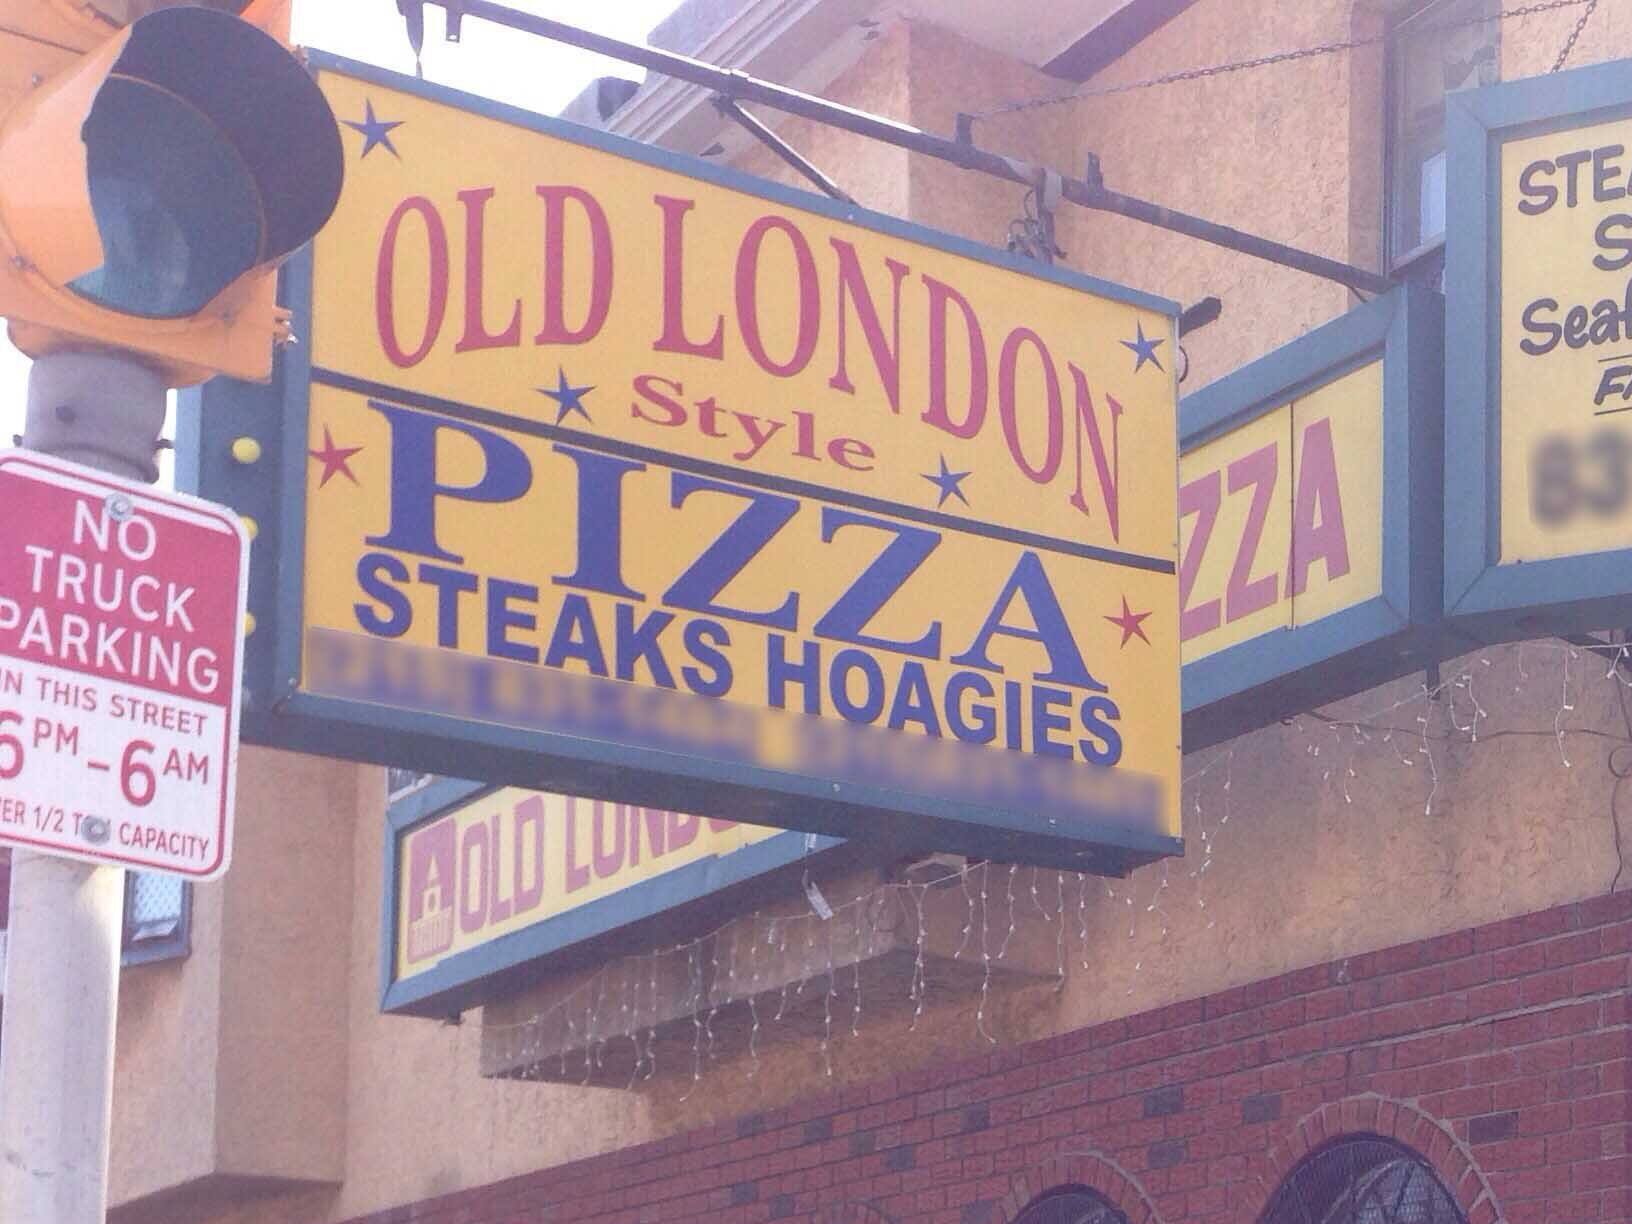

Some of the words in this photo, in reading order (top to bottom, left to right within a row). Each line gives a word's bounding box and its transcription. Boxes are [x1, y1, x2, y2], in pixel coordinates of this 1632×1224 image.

[375, 185, 614, 368] OLD
[653, 194, 1124, 543] LONDON
[630, 374, 876, 472] Style
[73, 499, 157, 561] NO
[364, 399, 1108, 693] PIZZA
[1179, 416, 1350, 642] ZZA
[25, 545, 196, 633] TRUCK
[0, 668, 23, 695] N
[37, 676, 97, 712] THIS
[110, 694, 208, 736] STREET
[353, 553, 734, 698] STEAKS
[767, 633, 1124, 768] HOAGIES
[33, 805, 64, 833] 1/2
[119, 821, 210, 860] CAPACITY
[459, 794, 544, 934] OLD
